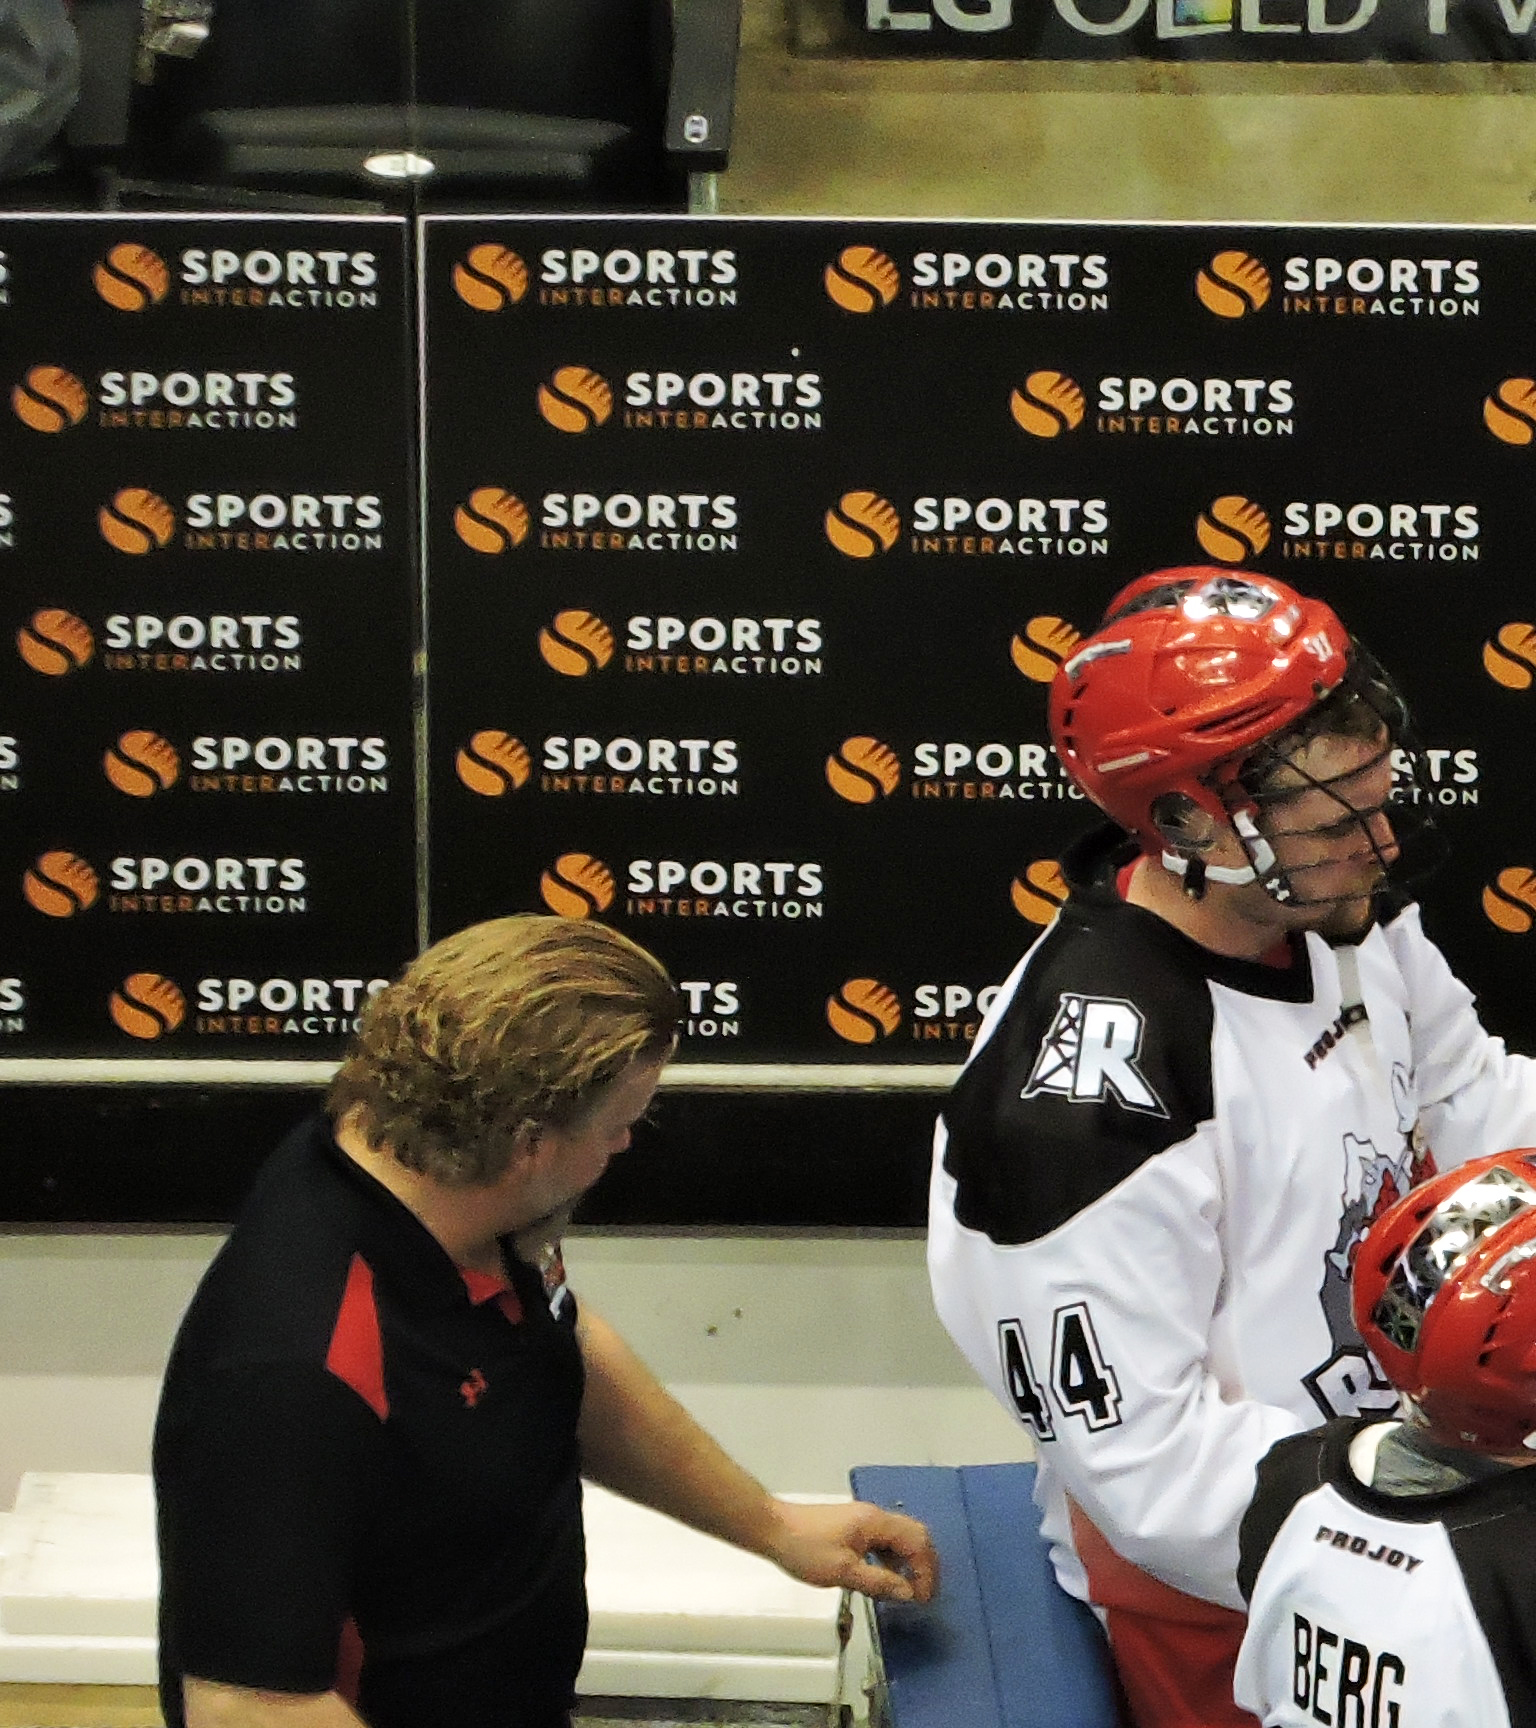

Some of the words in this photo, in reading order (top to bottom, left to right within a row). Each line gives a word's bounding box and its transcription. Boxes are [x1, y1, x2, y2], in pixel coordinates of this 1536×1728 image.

[182, 249, 377, 285] SPORTS
[541, 249, 737, 285] SPORTS
[912, 252, 1108, 288] SPORTS
[1284, 257, 1480, 293] SPORTS
[182, 288, 377, 308] INTERACTION
[541, 288, 737, 307] INTERACTION
[912, 291, 1108, 311] INTERACTION
[1284, 296, 1480, 317] INTERACTION
[100, 371, 296, 407] SPORTS
[625, 372, 822, 408] SPORTS
[1098, 377, 1294, 413] SPORTS
[100, 411, 296, 429] INTERACTION
[625, 411, 822, 430] INTERACTION
[1098, 416, 1294, 436] INTERACTION
[186, 493, 382, 529] SPORTS
[542, 493, 738, 529] SPORTS
[913, 497, 1108, 533] SPORTS
[1284, 502, 1479, 538] SPORTS
[186, 532, 382, 551] INTERACTION
[542, 532, 738, 552] INTERACTION
[913, 536, 1108, 556] INTERACTION
[1284, 542, 1479, 561] INTERACTION
[105, 615, 301, 651] SPORTS
[627, 616, 822, 652] SPORTS
[105, 654, 301, 671] INTERACTION
[627, 656, 822, 675] INTERACTION
[192, 736, 387, 772] SPORTS
[543, 736, 738, 772] SPORTS
[192, 775, 387, 793] INTERACTION
[543, 775, 738, 796] INTERACTION
[111, 857, 306, 893] SPORTS
[628, 860, 823, 896] SPORTS
[111, 896, 306, 913] INTERACTION
[628, 900, 823, 918] INTERACTION
[998, 1302, 1123, 1442] 44
[1315, 1525, 1425, 1575] PROJOY
